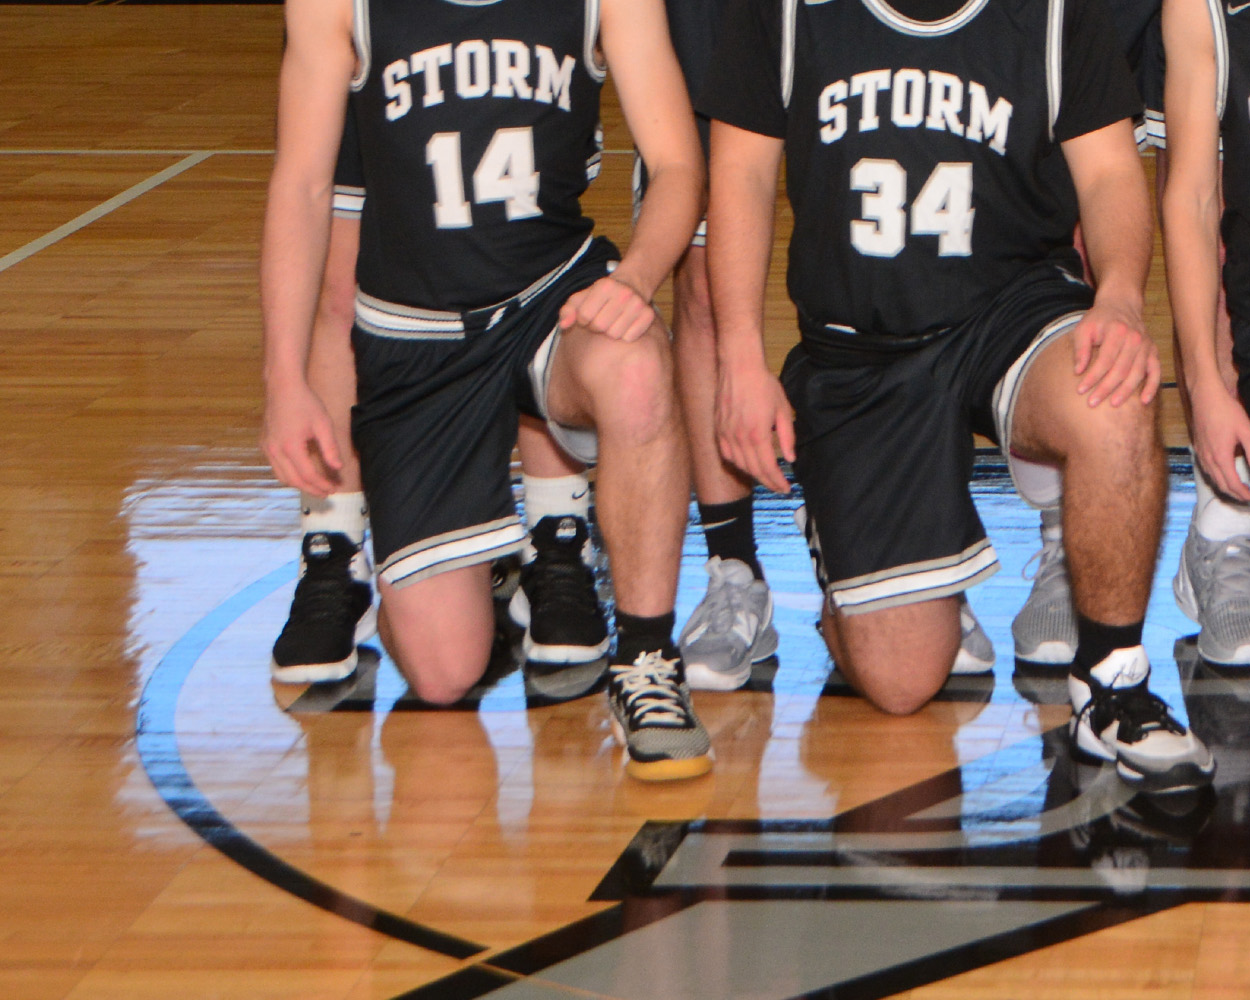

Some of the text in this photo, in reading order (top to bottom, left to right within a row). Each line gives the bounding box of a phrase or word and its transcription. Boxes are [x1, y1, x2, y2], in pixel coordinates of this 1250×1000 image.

[382, 39, 576, 121] STORM
[818, 68, 1013, 156] STORM
[425, 127, 544, 229] 14
[849, 158, 976, 257] 34
